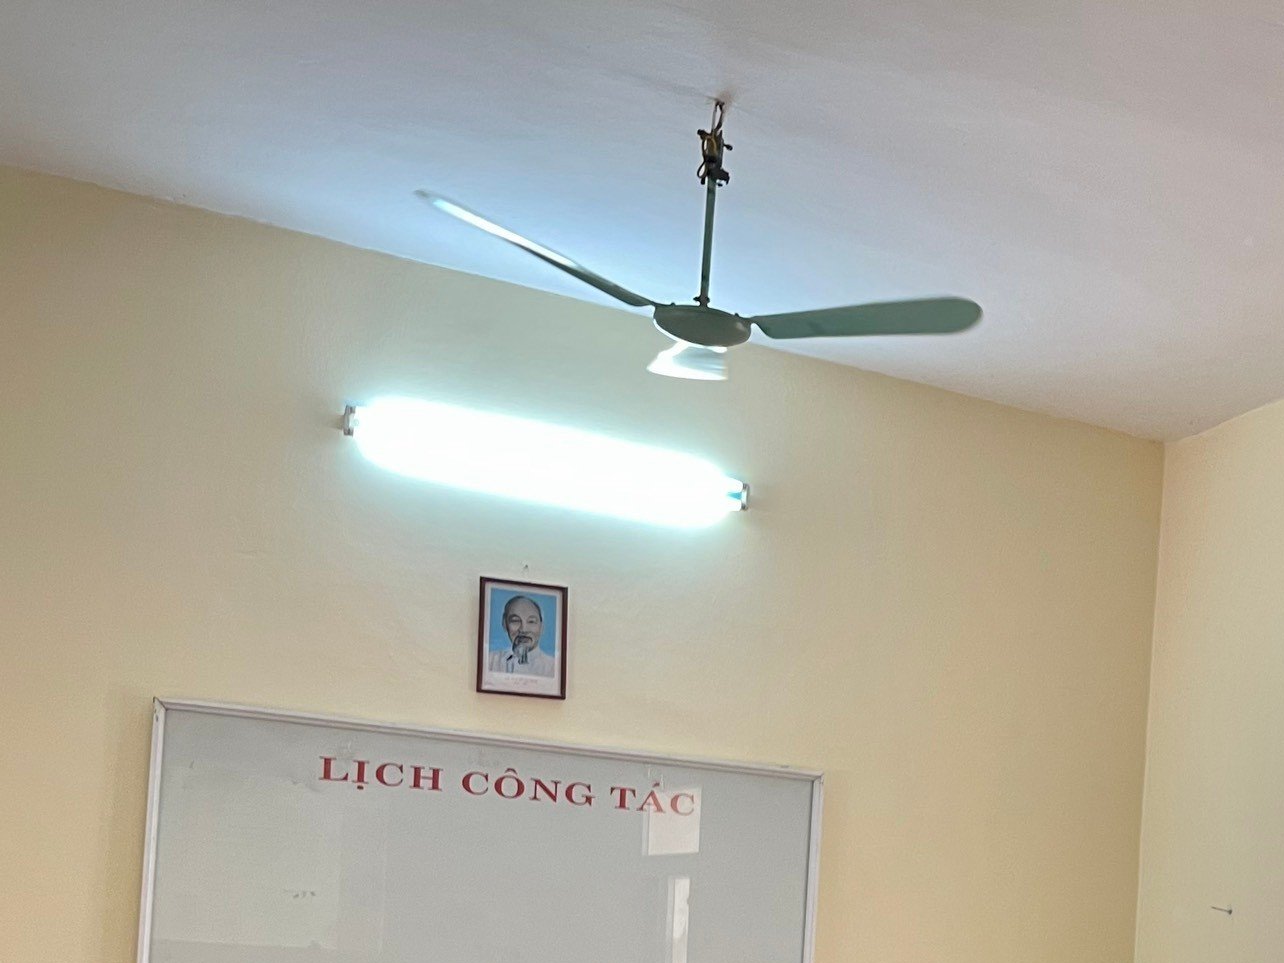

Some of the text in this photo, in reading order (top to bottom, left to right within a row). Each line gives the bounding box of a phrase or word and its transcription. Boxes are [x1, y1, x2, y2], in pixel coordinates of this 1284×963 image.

[319, 755, 696, 817] LỊCH CÔNG TÁC
